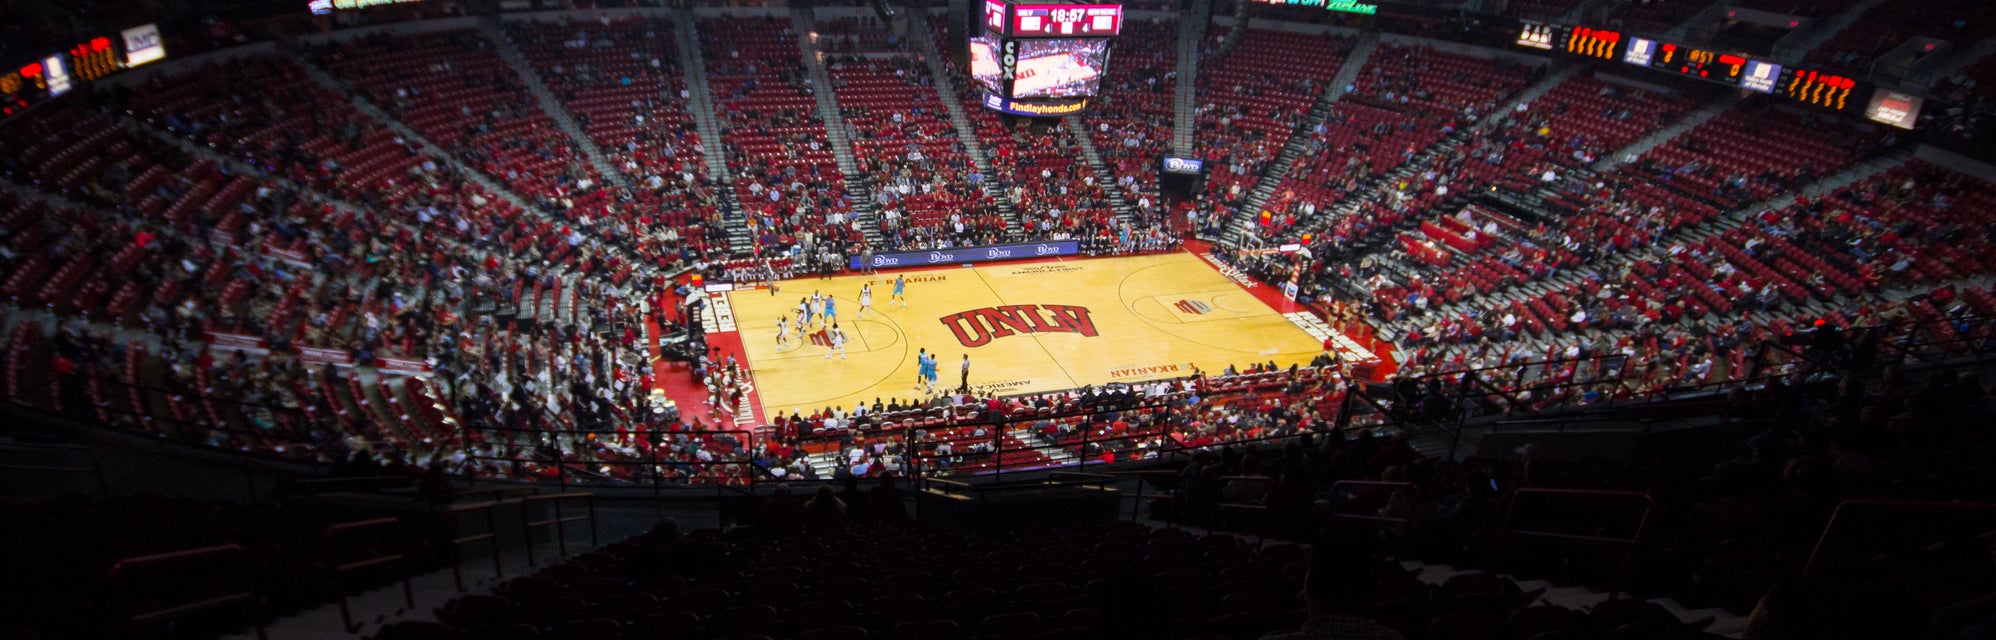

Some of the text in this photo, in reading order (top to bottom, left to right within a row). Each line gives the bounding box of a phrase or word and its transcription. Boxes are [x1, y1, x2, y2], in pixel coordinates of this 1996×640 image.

[1051, 8, 1085, 23] 18:57
[1003, 42, 1015, 80] COX
[1009, 101, 1081, 114] Findlayhonda.com
[939, 304, 1099, 348] UNLV
